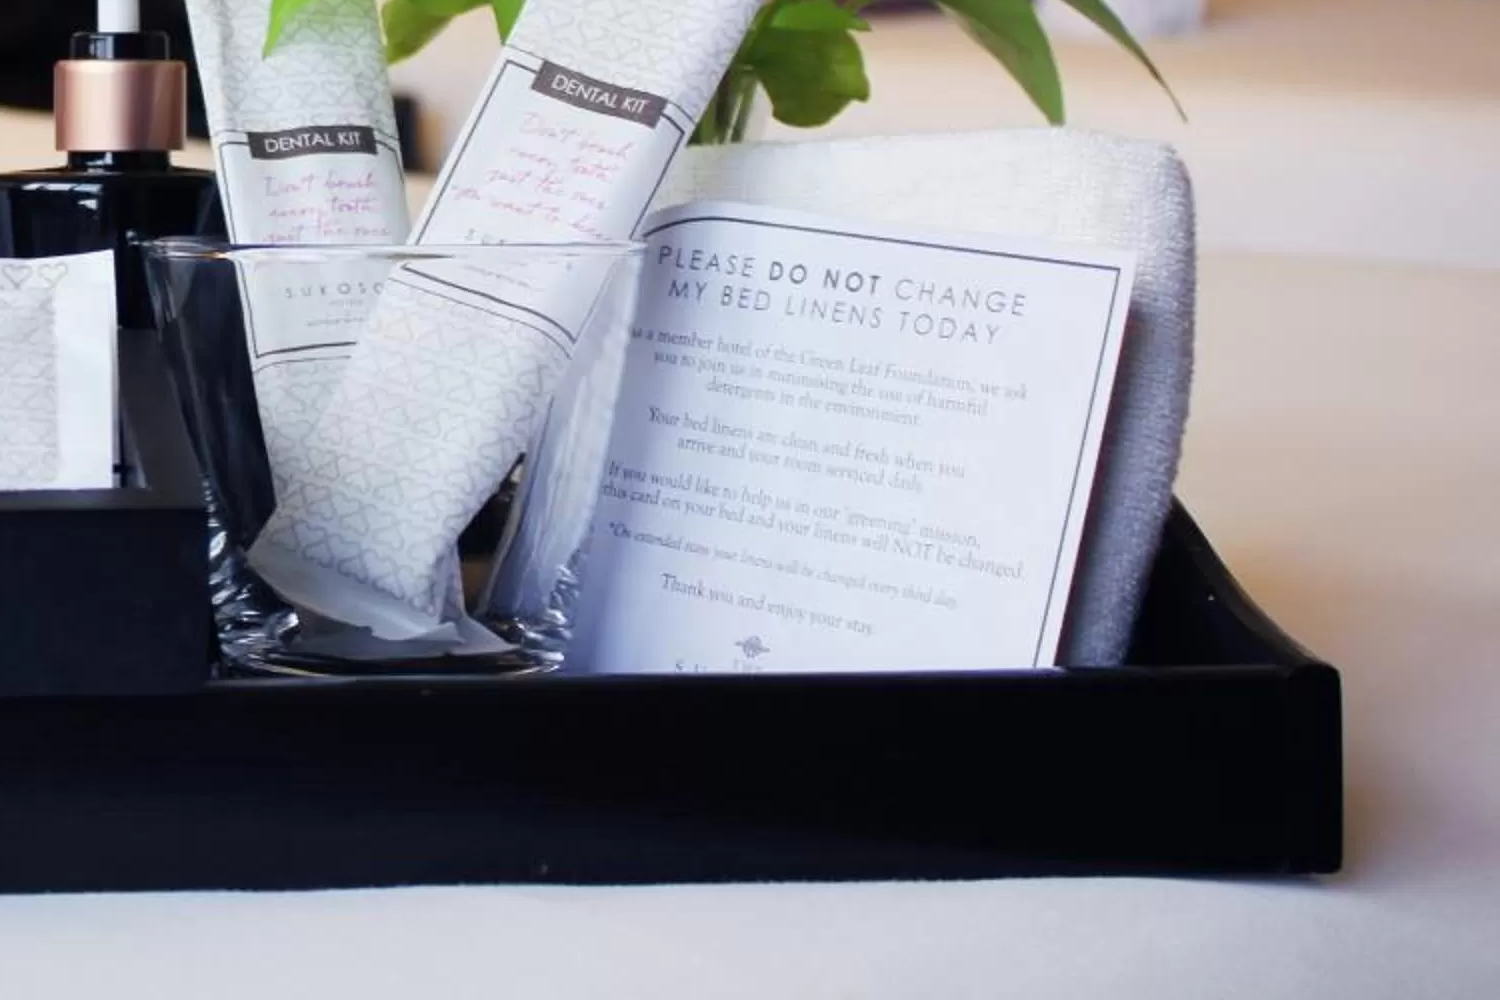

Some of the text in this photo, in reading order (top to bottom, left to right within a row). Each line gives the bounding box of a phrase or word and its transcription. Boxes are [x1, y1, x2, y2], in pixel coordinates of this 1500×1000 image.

[551, 73, 648, 115] DENTAL KIT
[264, 131, 361, 153] DENTAL KIT
[657, 245, 1027, 316] PLEASE DO NOT CHANGE
[668, 279, 1001, 345] MY BED LINENS TODAY
[657, 330, 713, 350] member
[717, 337, 751, 358] hotel
[755, 343, 772, 360] of
[774, 345, 797, 363] the
[799, 349, 845, 371] Green
[849, 357, 882, 377] Leaf
[654, 351, 678, 369] you
[697, 355, 726, 377] join
[852, 377, 875, 399] the
[927, 391, 989, 418] harmful
[798, 391, 821, 409] the
[648, 404, 681, 427] Your
[682, 411, 709, 433] bed
[712, 416, 754, 440] linens
[781, 430, 818, 452] clean
[822, 438, 851, 457] and
[854, 442, 890, 465] fresh
[894, 452, 934, 472] when
[937, 462, 965, 480] you
[677, 436, 718, 453] arrive
[720, 441, 746, 459] and
[783, 454, 821, 473] room
[623, 466, 647, 484] you
[650, 471, 693, 491] would
[695, 476, 722, 498] like
[740, 484, 774, 510] help
[812, 505, 841, 521] our
[629, 488, 662, 507] card
[662, 496, 682, 512] on
[684, 499, 717, 519] your
[718, 505, 746, 524] bed
[747, 512, 775, 529] and
[777, 518, 811, 538] your
[812, 519, 858, 545] linens
[861, 531, 890, 554] will
[892, 538, 934, 561] NOT
[935, 545, 956, 567] be
[660, 571, 704, 597] Thank
[706, 587, 735, 606] you
[736, 593, 767, 612] and
[767, 601, 806, 626] enjoy
[808, 609, 843, 631] your
